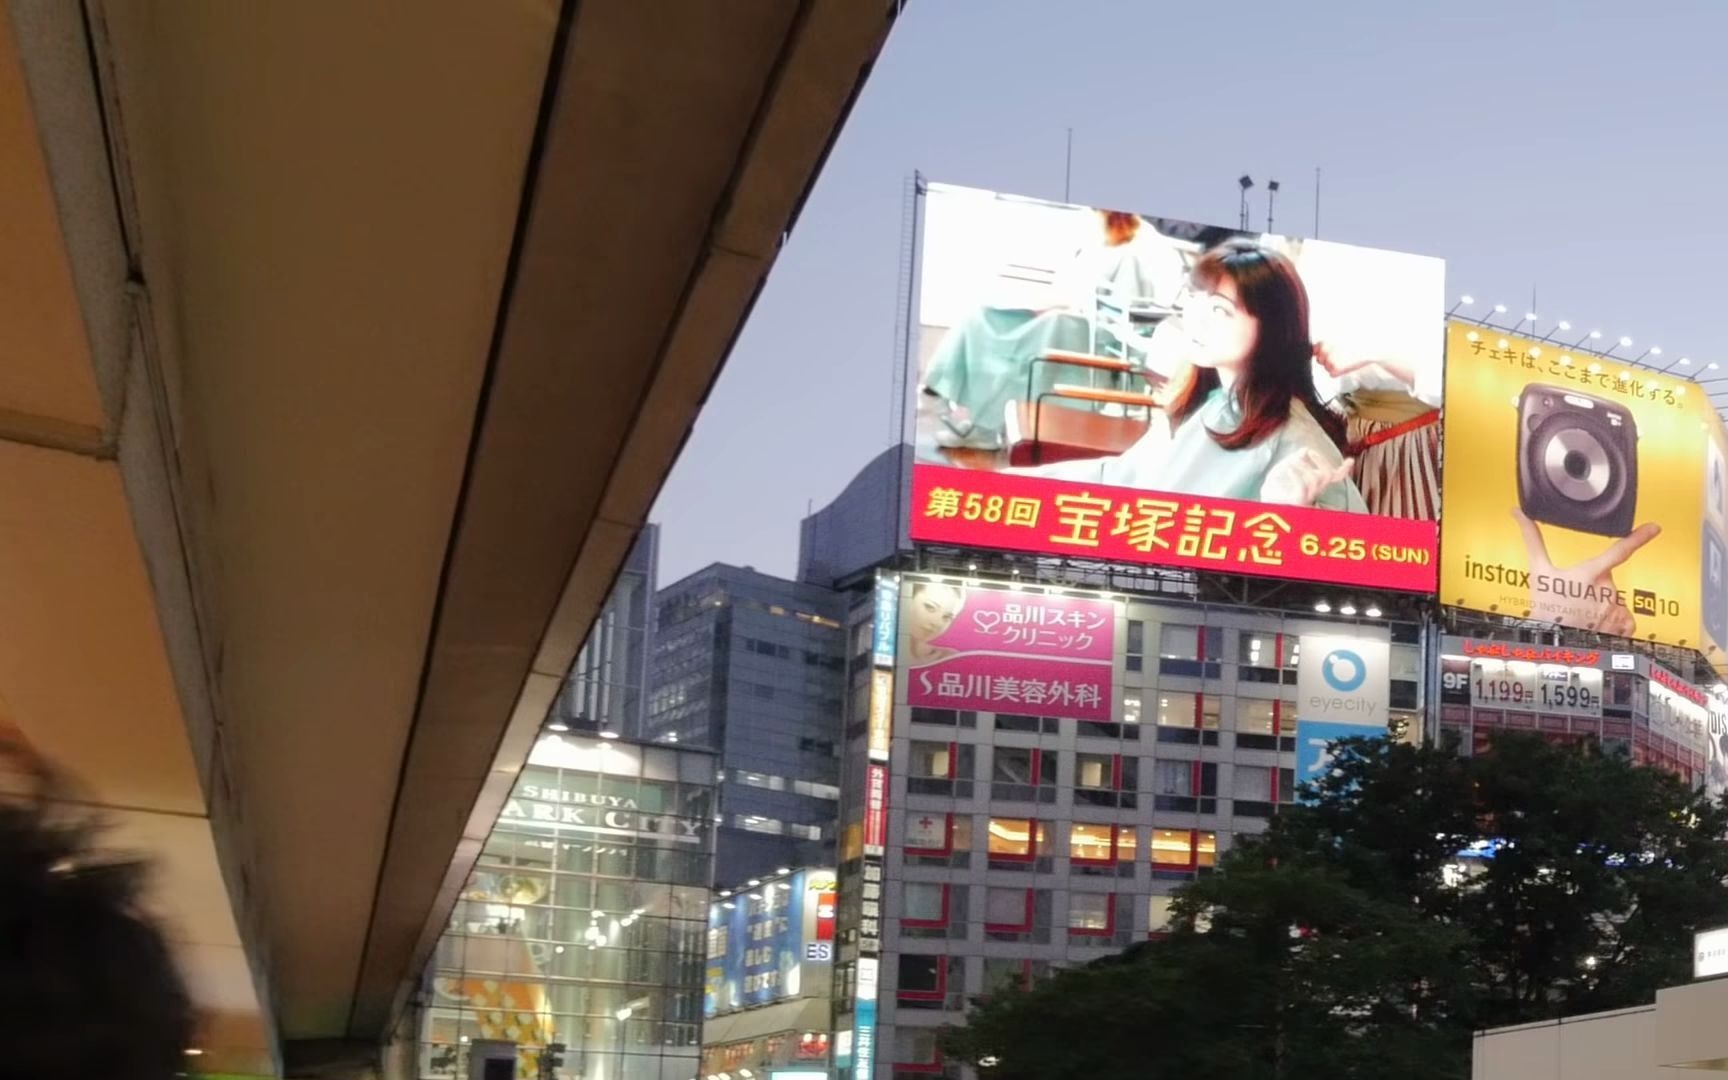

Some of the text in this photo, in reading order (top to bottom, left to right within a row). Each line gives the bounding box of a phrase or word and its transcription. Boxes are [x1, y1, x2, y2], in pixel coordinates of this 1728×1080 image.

[925, 487, 1430, 566] 第58回 宝塚記念 6.25 (SUN)
[1464, 555, 1531, 589] instax
[1537, 574, 1627, 607] SQUARE
[1002, 603, 1106, 630] 品川スキン
[1003, 626, 1093, 650] クリニック
[937, 672, 1102, 709] 品川美容外科
[1443, 672, 1469, 690] 9F
[1309, 696, 1377, 716] eyecity
[523, 785, 638, 809] SHIBUYA
